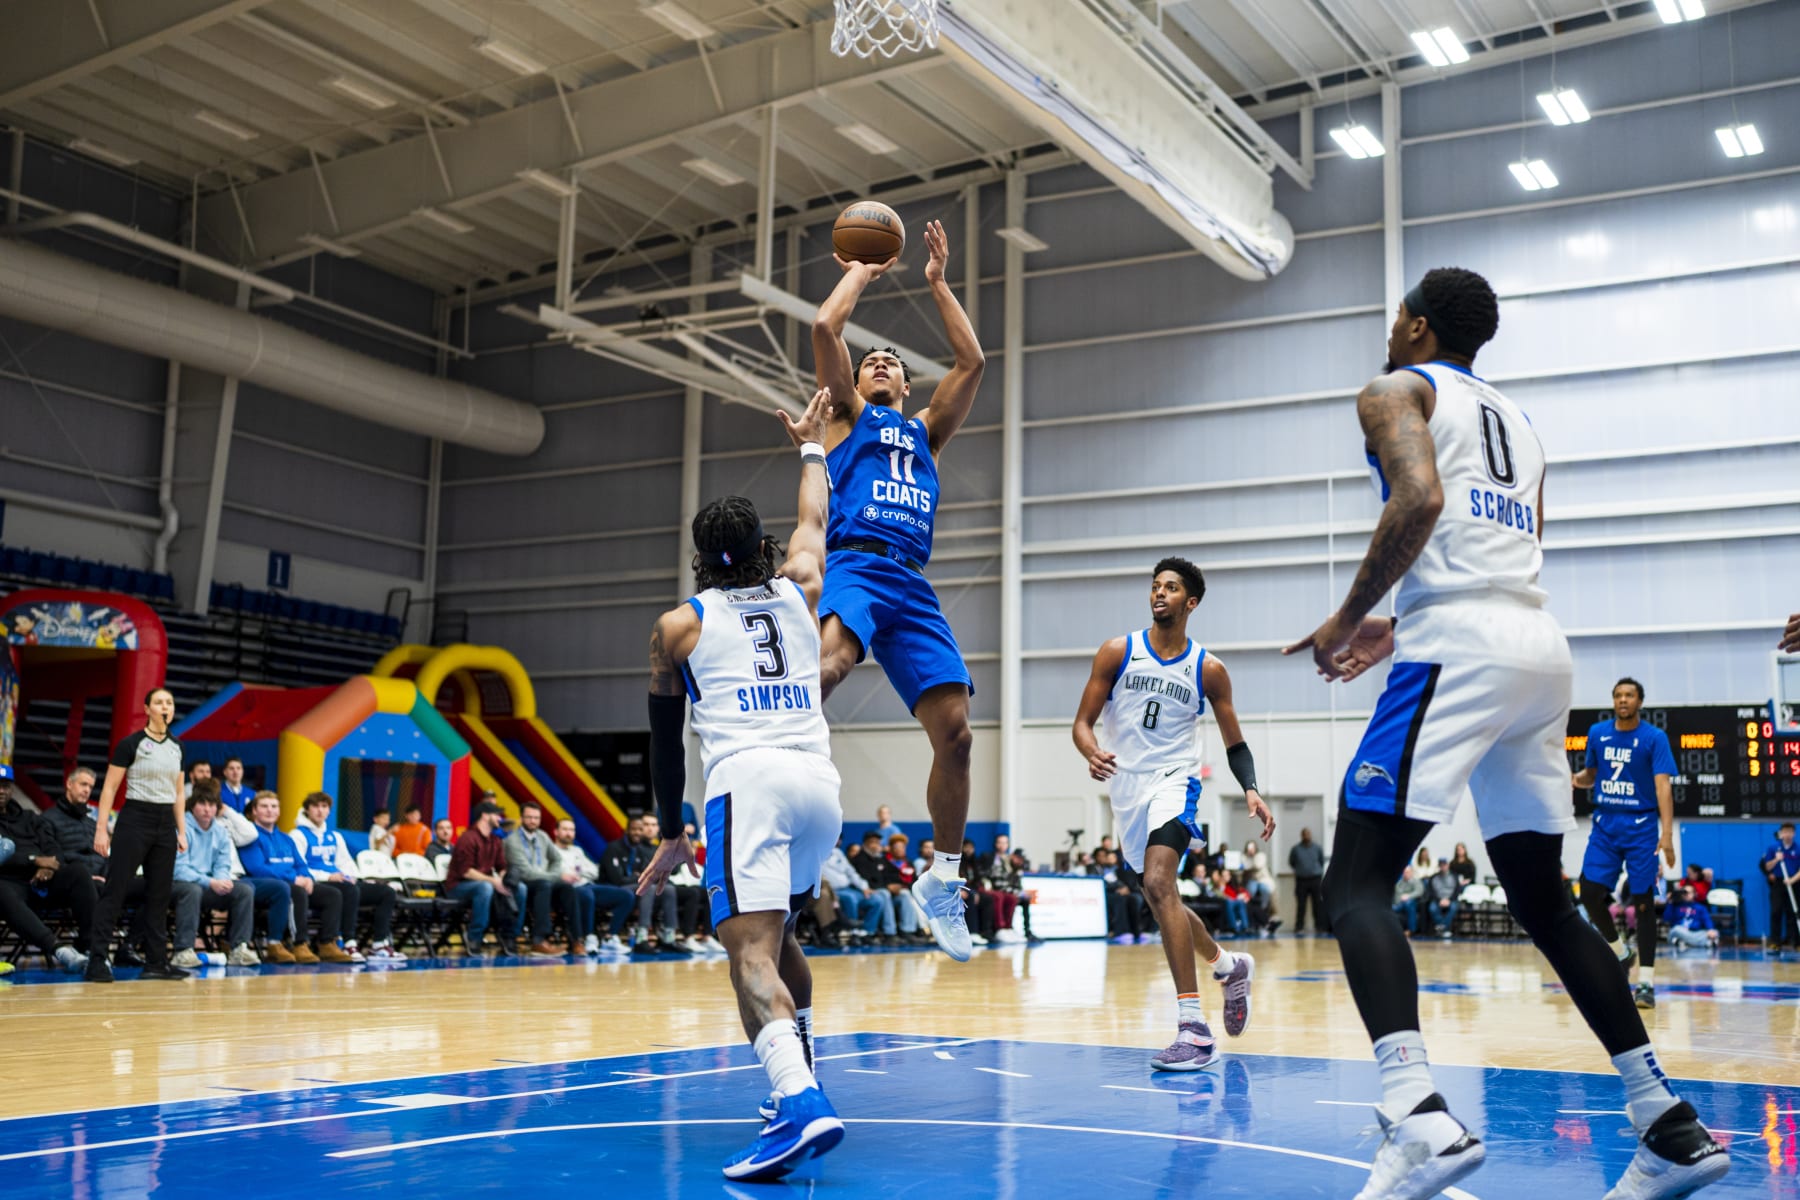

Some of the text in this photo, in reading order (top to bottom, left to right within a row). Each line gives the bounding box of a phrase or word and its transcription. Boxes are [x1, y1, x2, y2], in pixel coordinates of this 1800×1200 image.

[1477, 401, 1518, 488] 0
[889, 450, 917, 485] 11
[873, 479, 931, 513] COATS
[740, 609, 789, 681] 3
[737, 685, 812, 712] SIMPSON
[1125, 675, 1191, 704] LAKELAND
[1142, 700, 1161, 730] 8
[1746, 721, 1759, 739] 0
[1762, 721, 1774, 739] 0
[1604, 746, 1632, 763] BLUE
[1747, 740, 1800, 758] 2 1 14
[1611, 762, 1624, 781] 7
[1749, 759, 1761, 777] 3
[1769, 761, 1776, 776] 1
[1601, 780, 1635, 796] COATS
